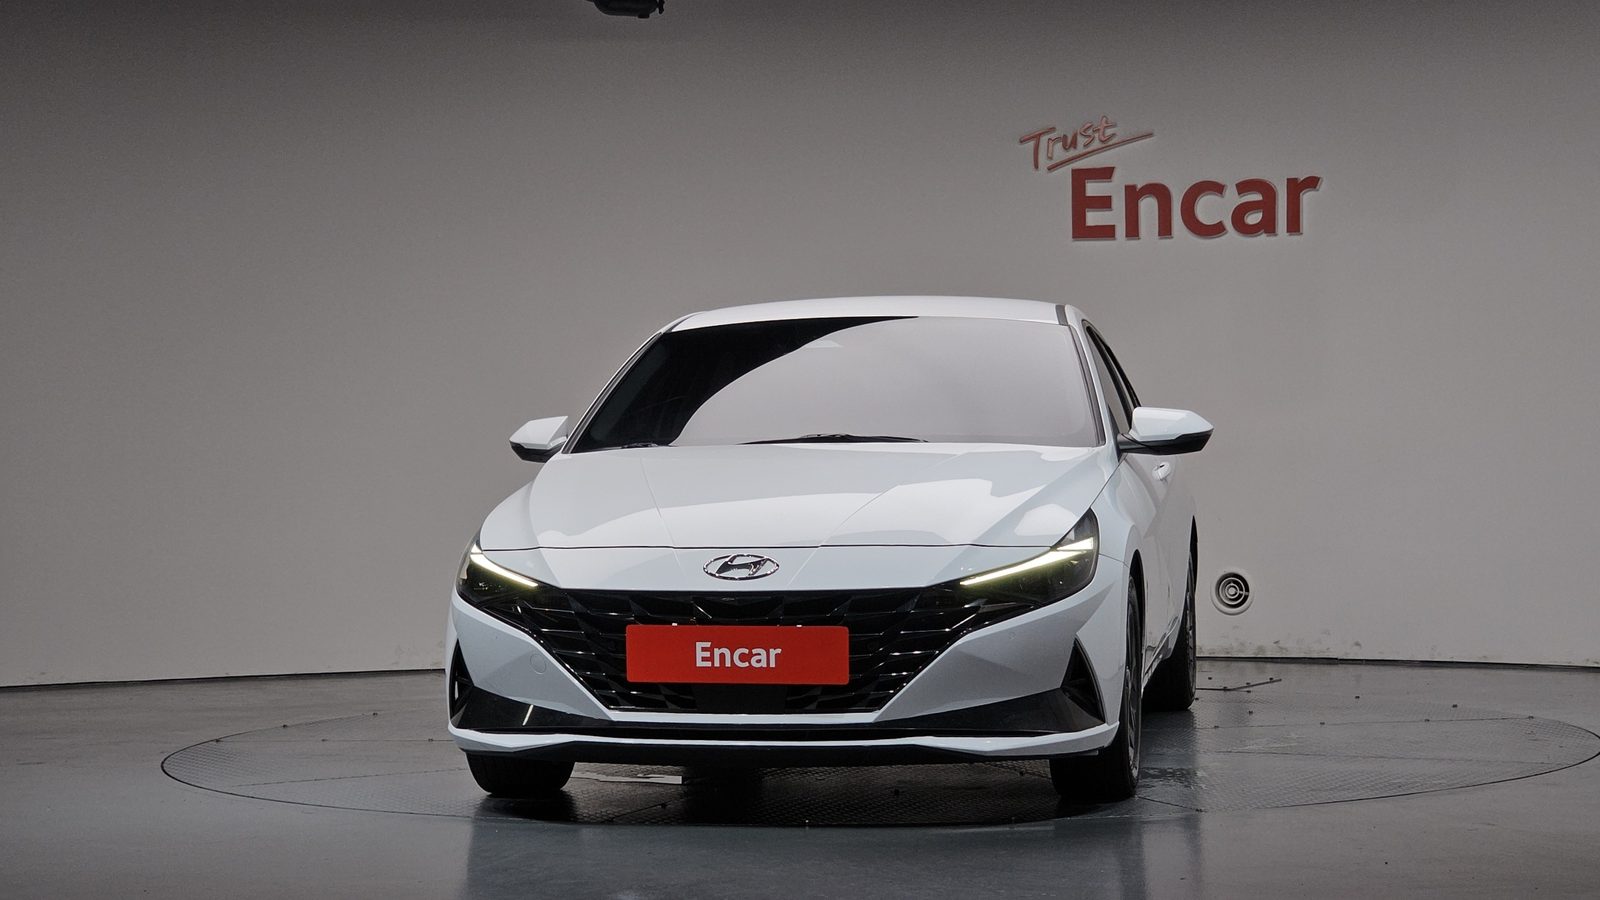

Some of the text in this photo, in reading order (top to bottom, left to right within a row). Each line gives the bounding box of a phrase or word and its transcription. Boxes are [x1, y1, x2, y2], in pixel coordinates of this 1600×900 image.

[1019, 115, 1117, 170] Trust
[1071, 166, 1322, 240] Encar
[695, 641, 782, 668] Encar
